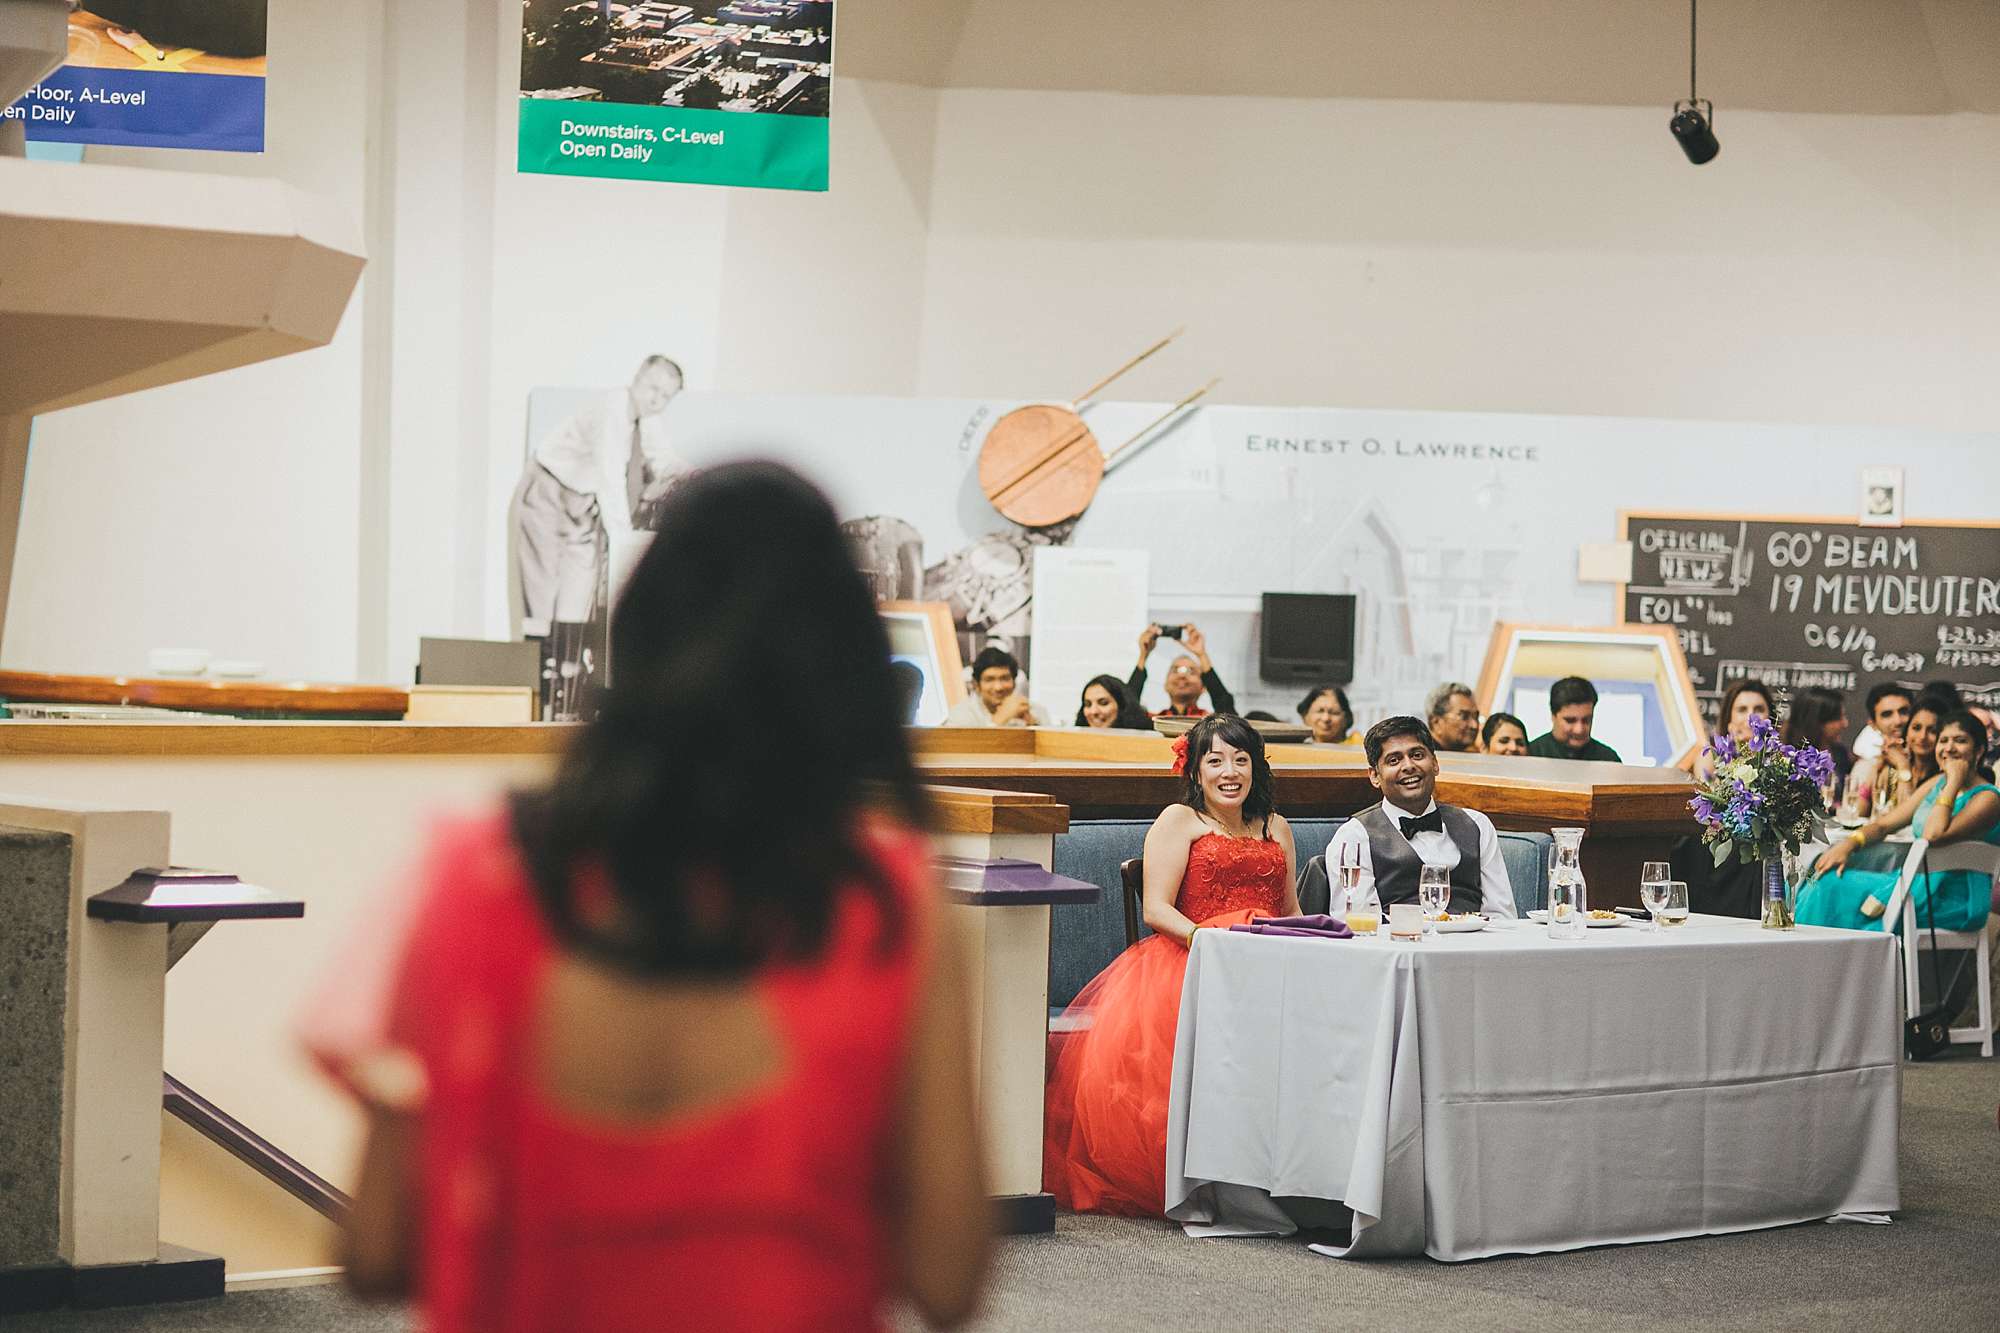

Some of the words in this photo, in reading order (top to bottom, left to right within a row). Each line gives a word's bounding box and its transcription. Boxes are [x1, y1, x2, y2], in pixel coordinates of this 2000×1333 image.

[79, 87, 146, 106] A-Level
[0, 104, 25, 119] en
[32, 105, 76, 124] Daily
[560, 120, 658, 143] Downstairs,
[661, 127, 725, 146] C-Level
[560, 140, 606, 158] Open
[610, 143, 652, 163] Daily
[1362, 438, 1387, 456] O.
[1825, 534, 1918, 570] BEAM
[1769, 574, 1804, 614] 19
